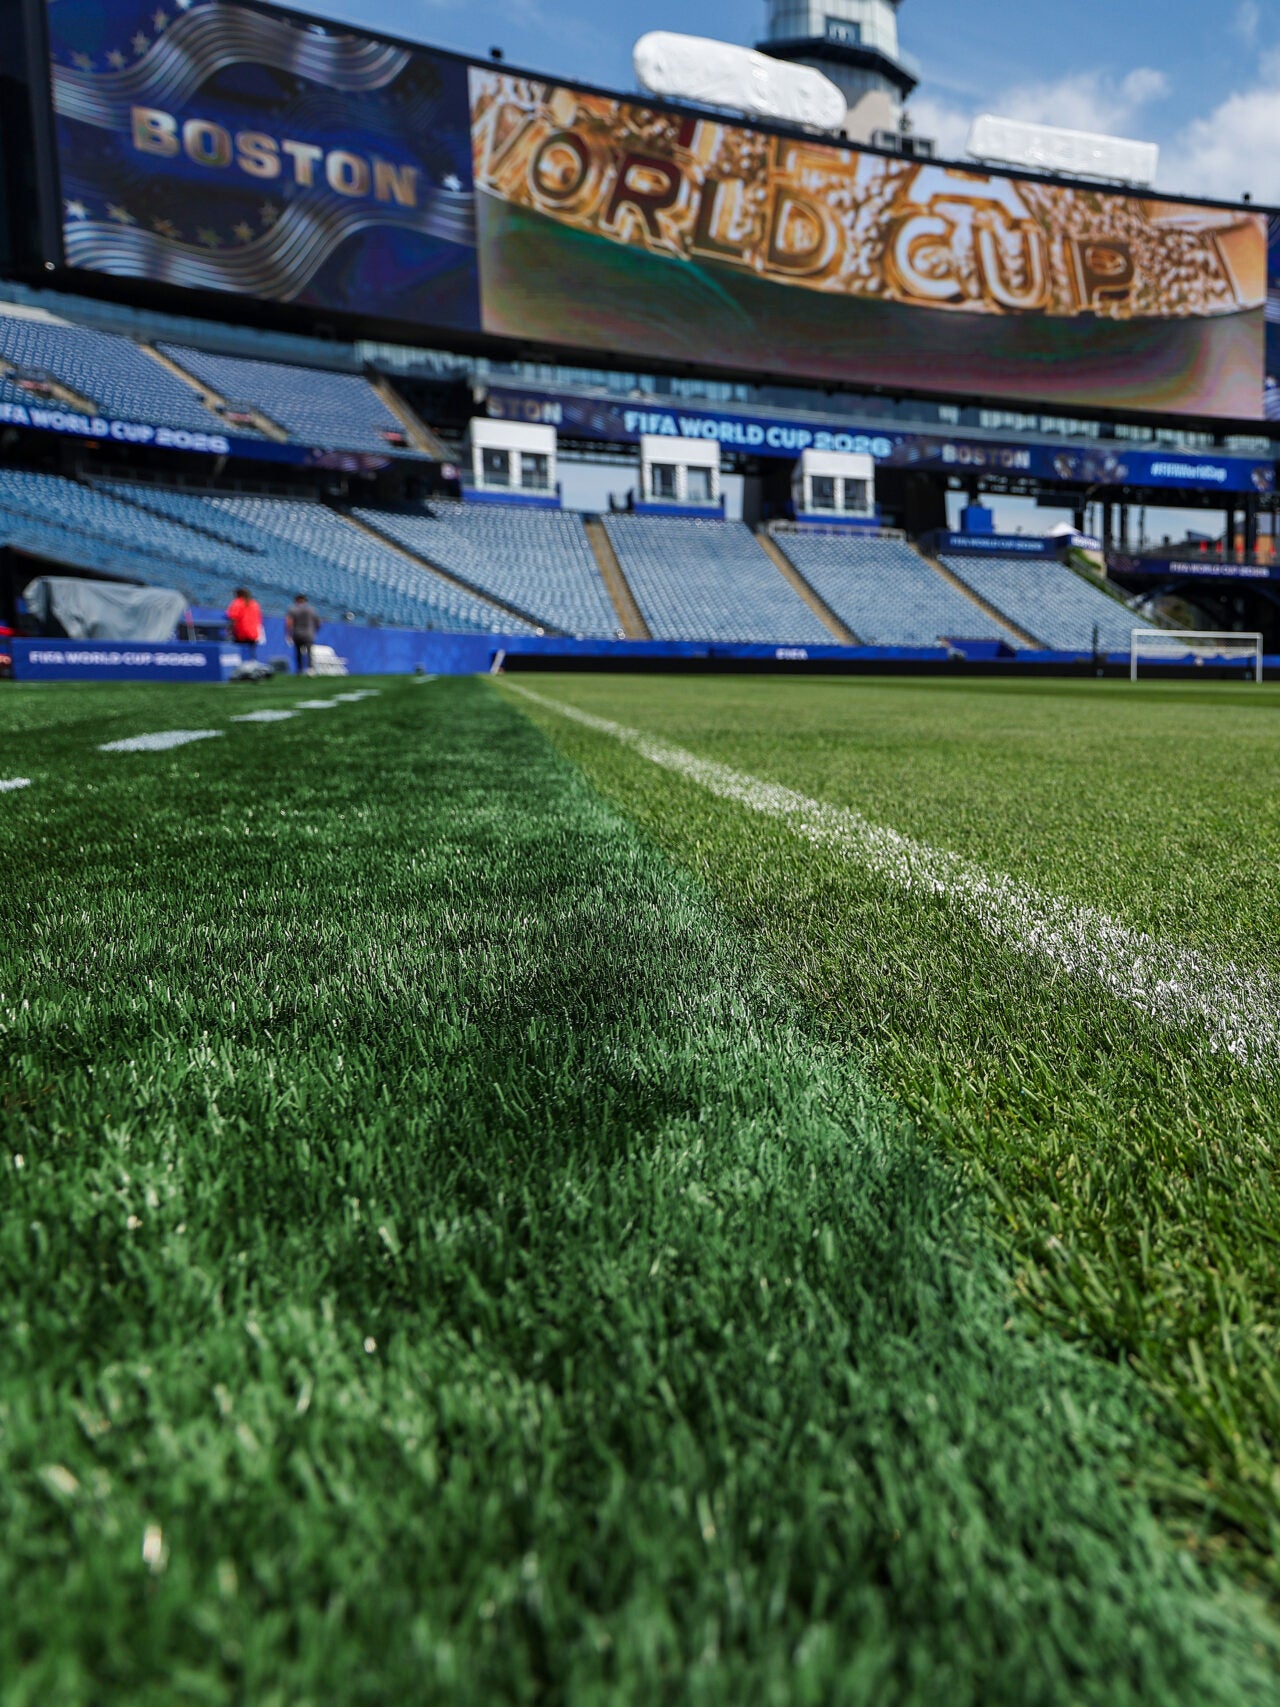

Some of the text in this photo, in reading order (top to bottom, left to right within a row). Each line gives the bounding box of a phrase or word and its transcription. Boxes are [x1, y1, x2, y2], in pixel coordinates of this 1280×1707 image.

[131, 104, 418, 206] BOSTON
[892, 212, 1136, 320] CUP
[29, 407, 109, 437] WORLD
[110, 420, 154, 443] CUP
[155, 427, 230, 454] 2026
[624, 410, 892, 457] FIFA WORLD CUP 2026
[942, 444, 1030, 469] BOSTON
[29, 650, 65, 665] FIFA
[65, 650, 122, 666] WORLD
[122, 651, 153, 666] CUP
[154, 652, 207, 667] 2026
